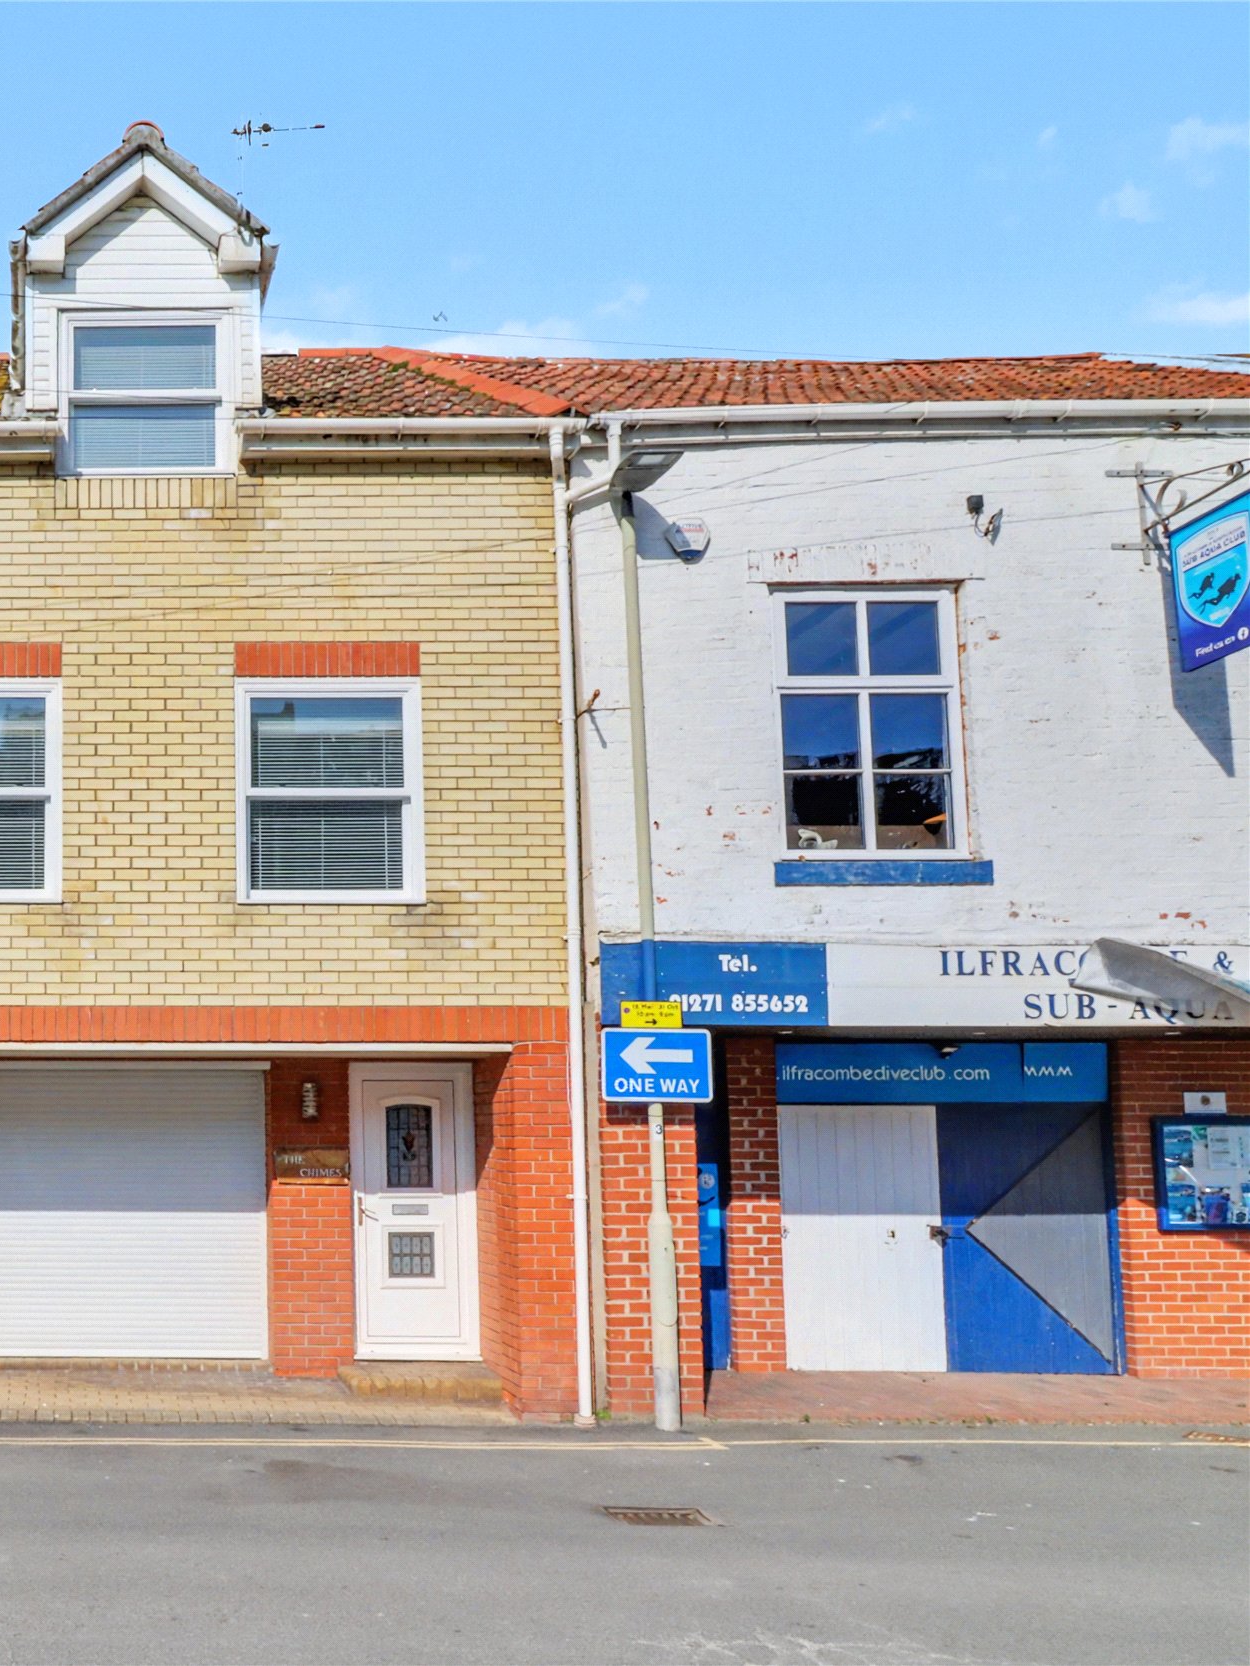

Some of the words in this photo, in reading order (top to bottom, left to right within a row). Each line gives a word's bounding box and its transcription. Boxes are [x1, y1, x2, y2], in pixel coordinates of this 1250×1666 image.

[718, 954, 758, 973] Tel.
[731, 993, 809, 1013] 855652
[1024, 993, 1096, 1020] SUB
[614, 1077, 655, 1094] ONE
[660, 1078, 700, 1094] WAY
[655, 1123, 663, 1135] 3
[281, 1153, 305, 1165] THE
[299, 1168, 342, 1178] CHIMES
